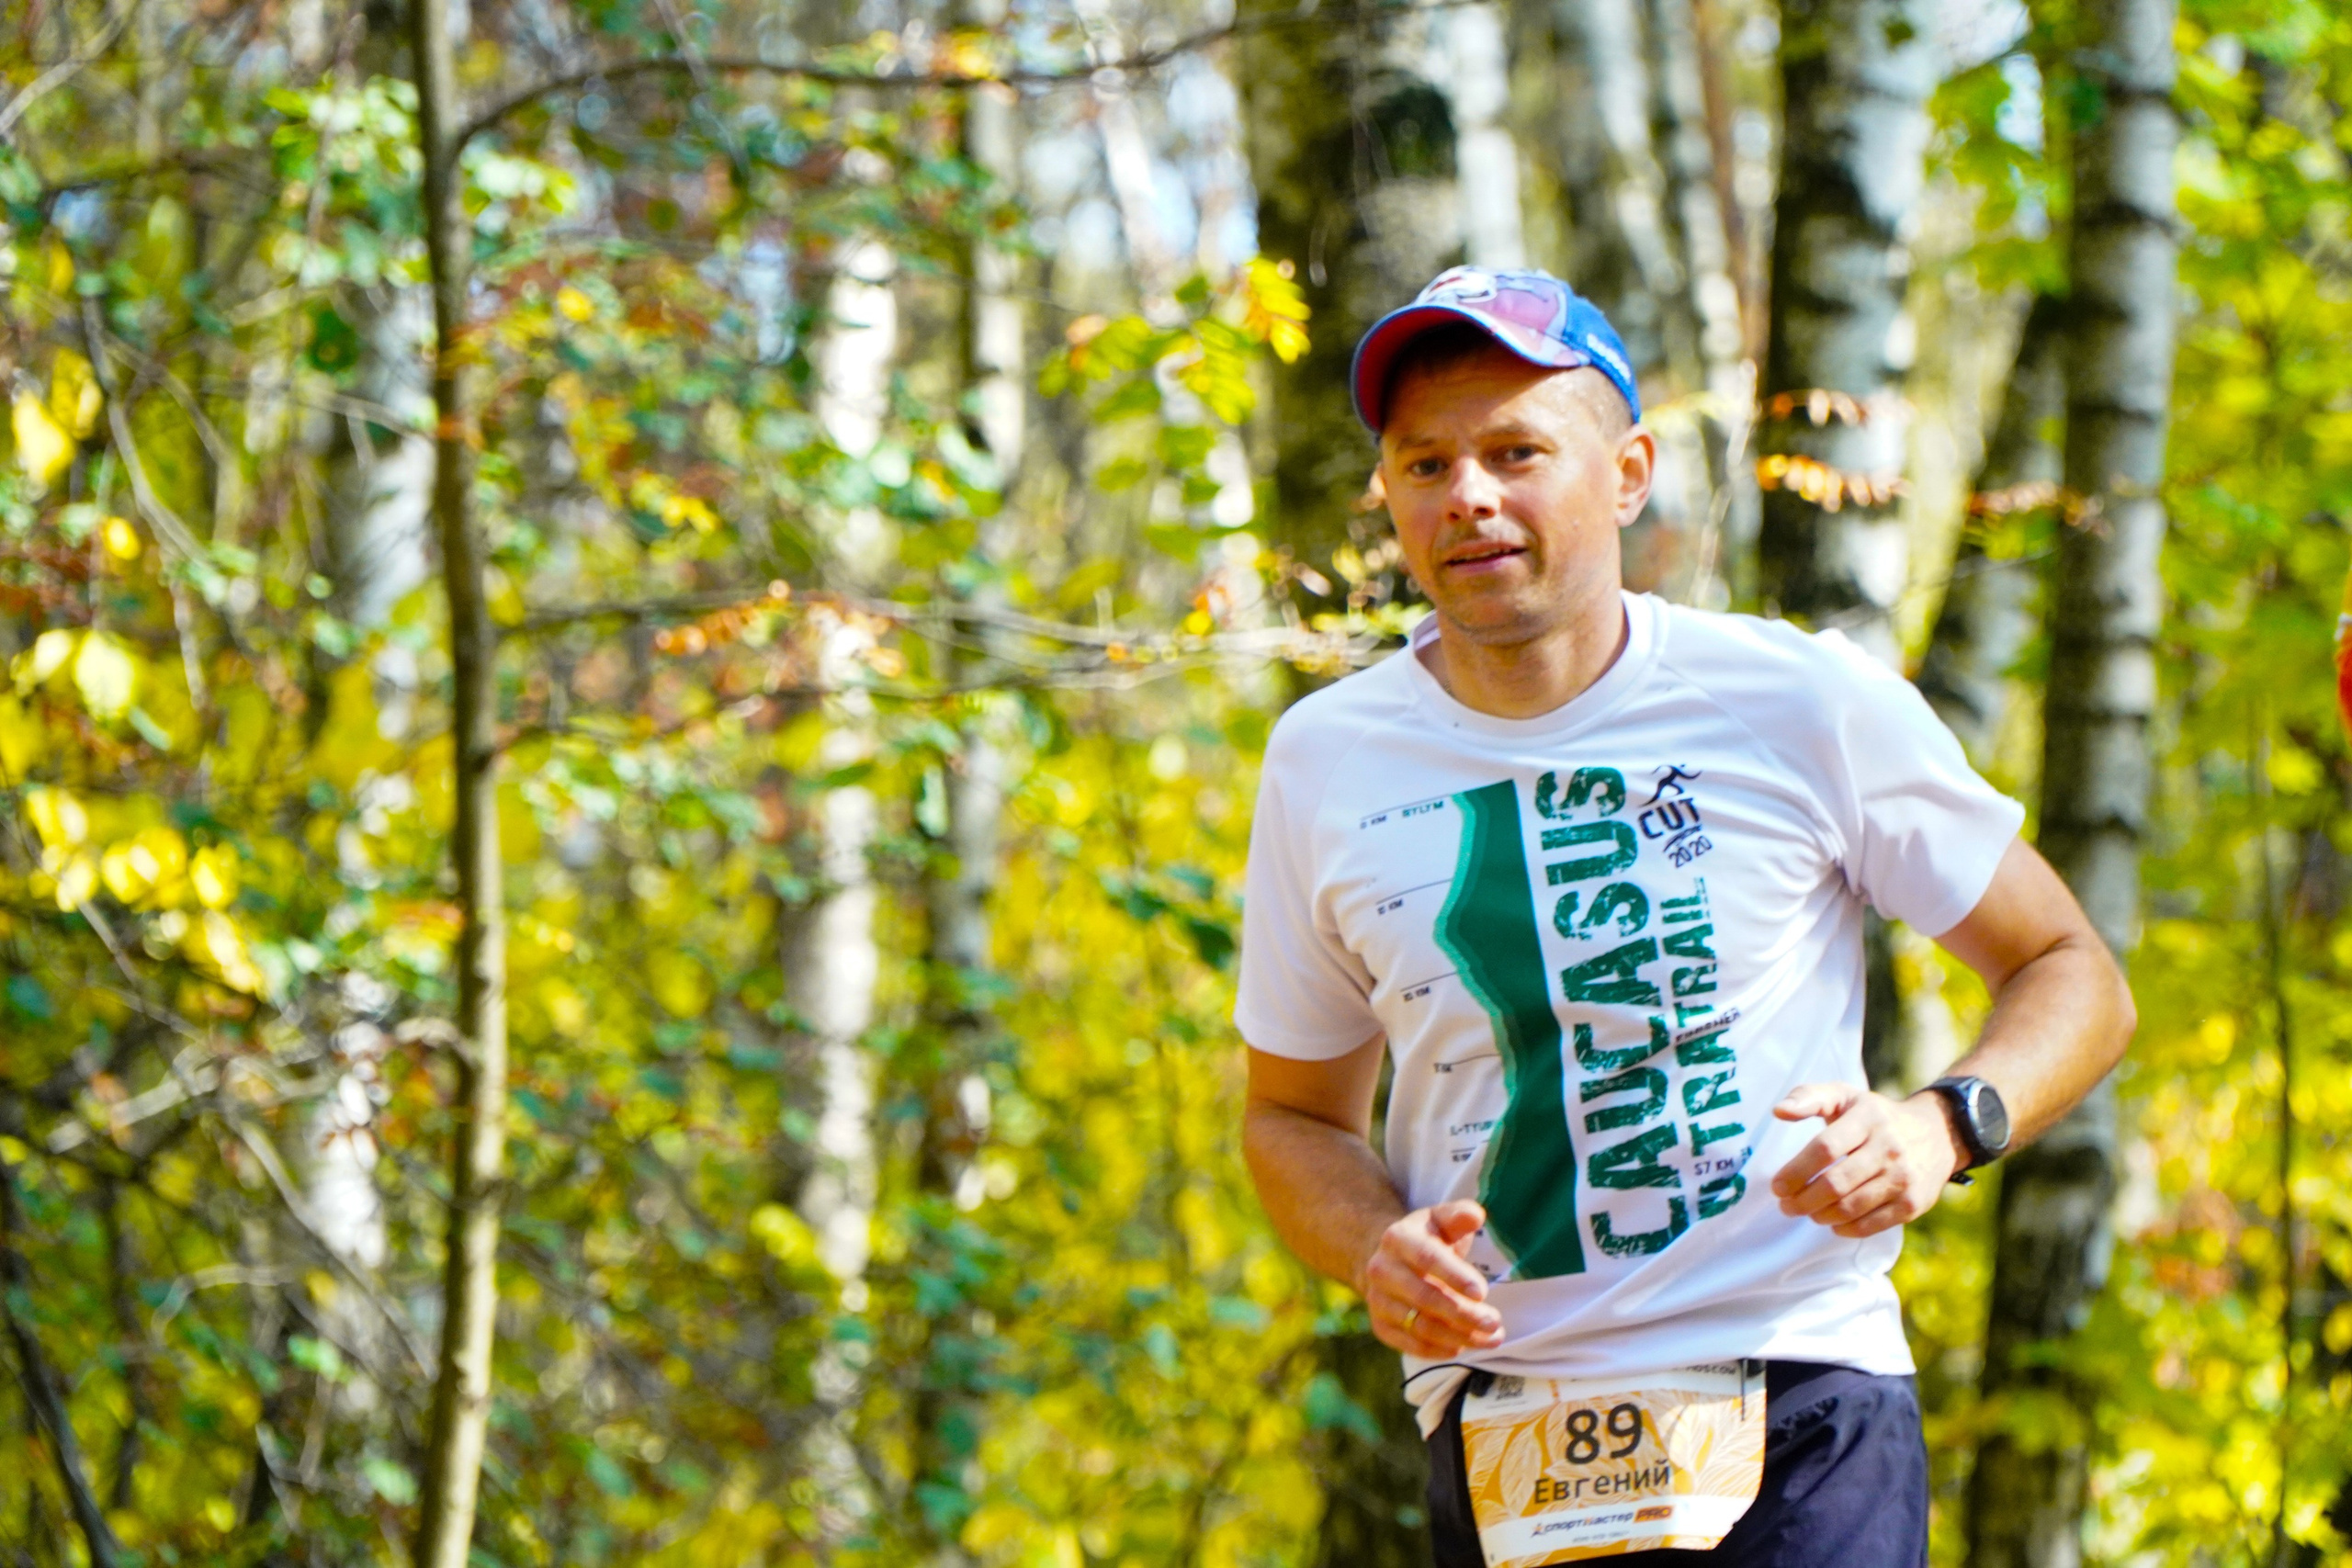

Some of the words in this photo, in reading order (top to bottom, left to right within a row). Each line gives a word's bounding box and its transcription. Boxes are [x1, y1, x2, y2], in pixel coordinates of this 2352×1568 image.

[1637, 797, 1701, 840] CUT
[1668, 835, 1713, 868] 2020
[1535, 766, 1690, 1260] CAUCASUS
[1565, 1402, 1643, 1464] 89
[1533, 1459, 1671, 1504] Евгений
